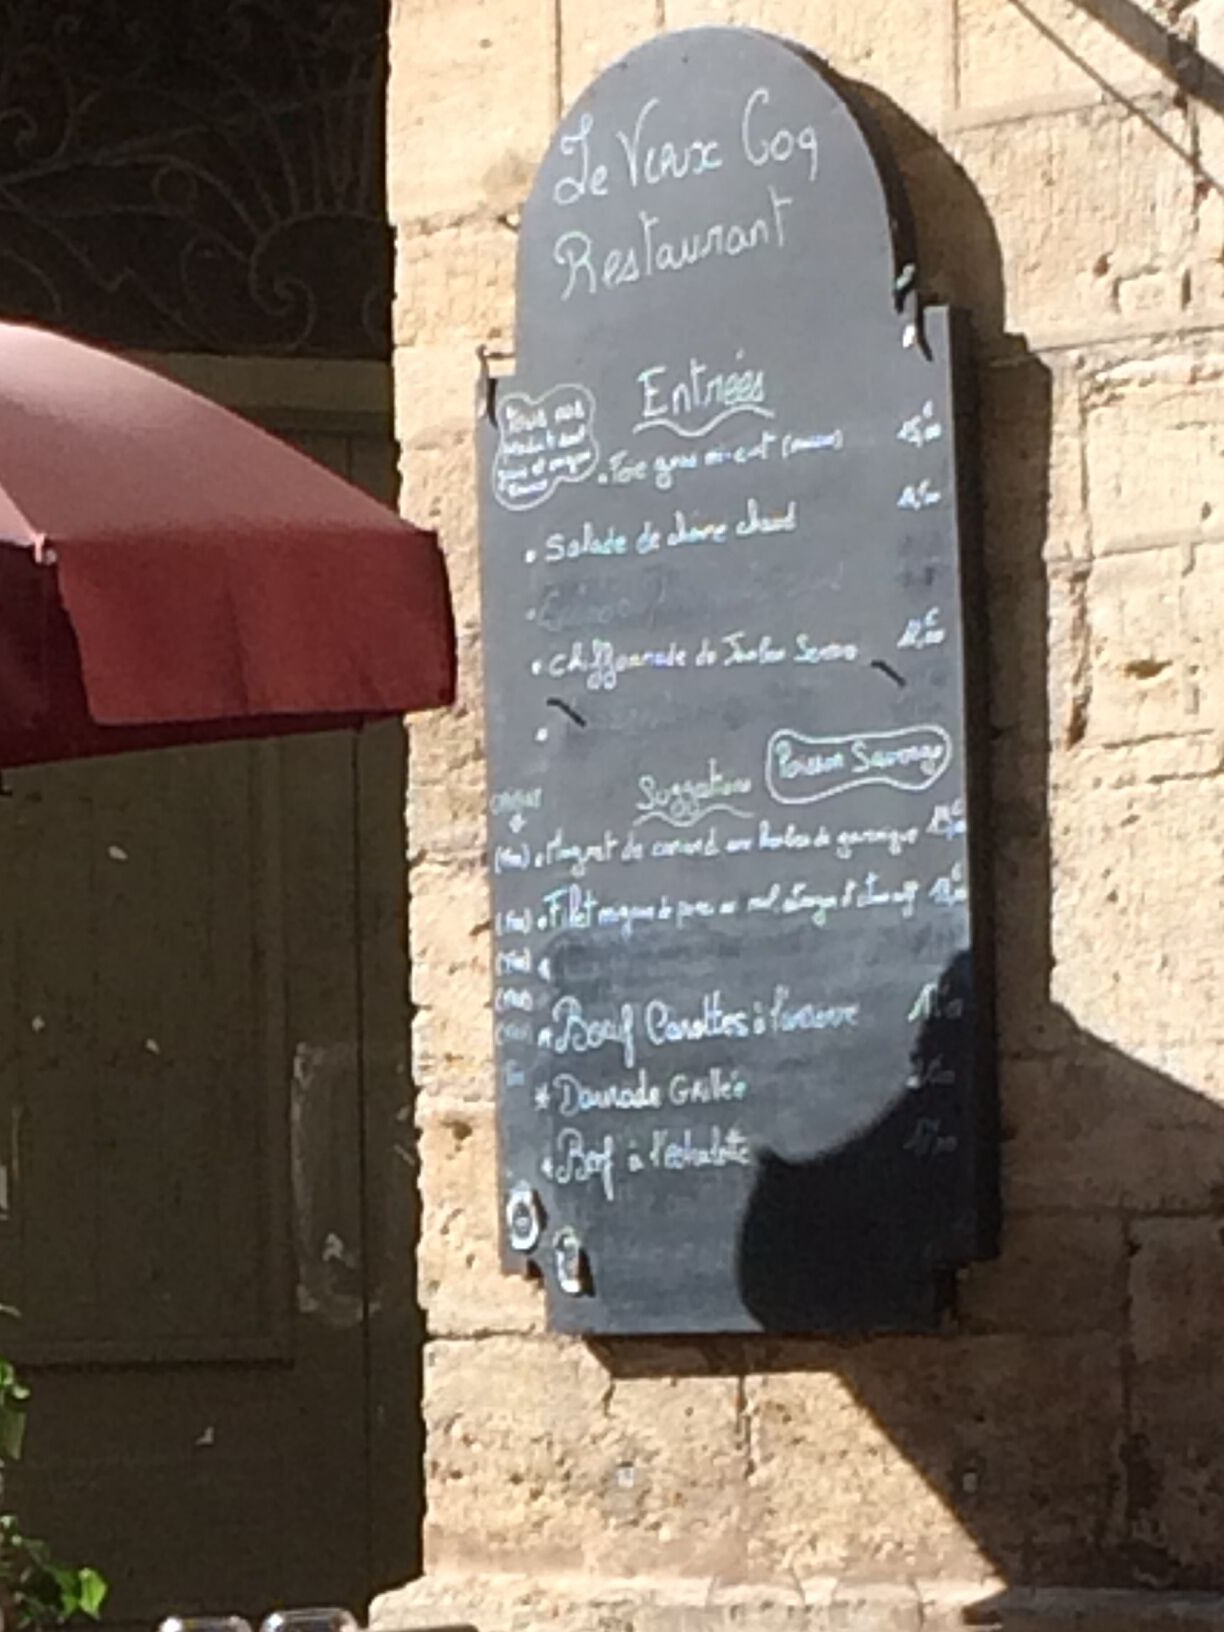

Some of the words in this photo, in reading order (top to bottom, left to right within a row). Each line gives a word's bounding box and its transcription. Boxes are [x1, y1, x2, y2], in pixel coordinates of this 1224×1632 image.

[553, 112, 608, 206] Le
[741, 87, 818, 182] Coq
[553, 185, 794, 302] Restaurant
[636, 349, 766, 418] Entrées
[545, 522, 627, 561] Salade
[636, 521, 660, 554] de
